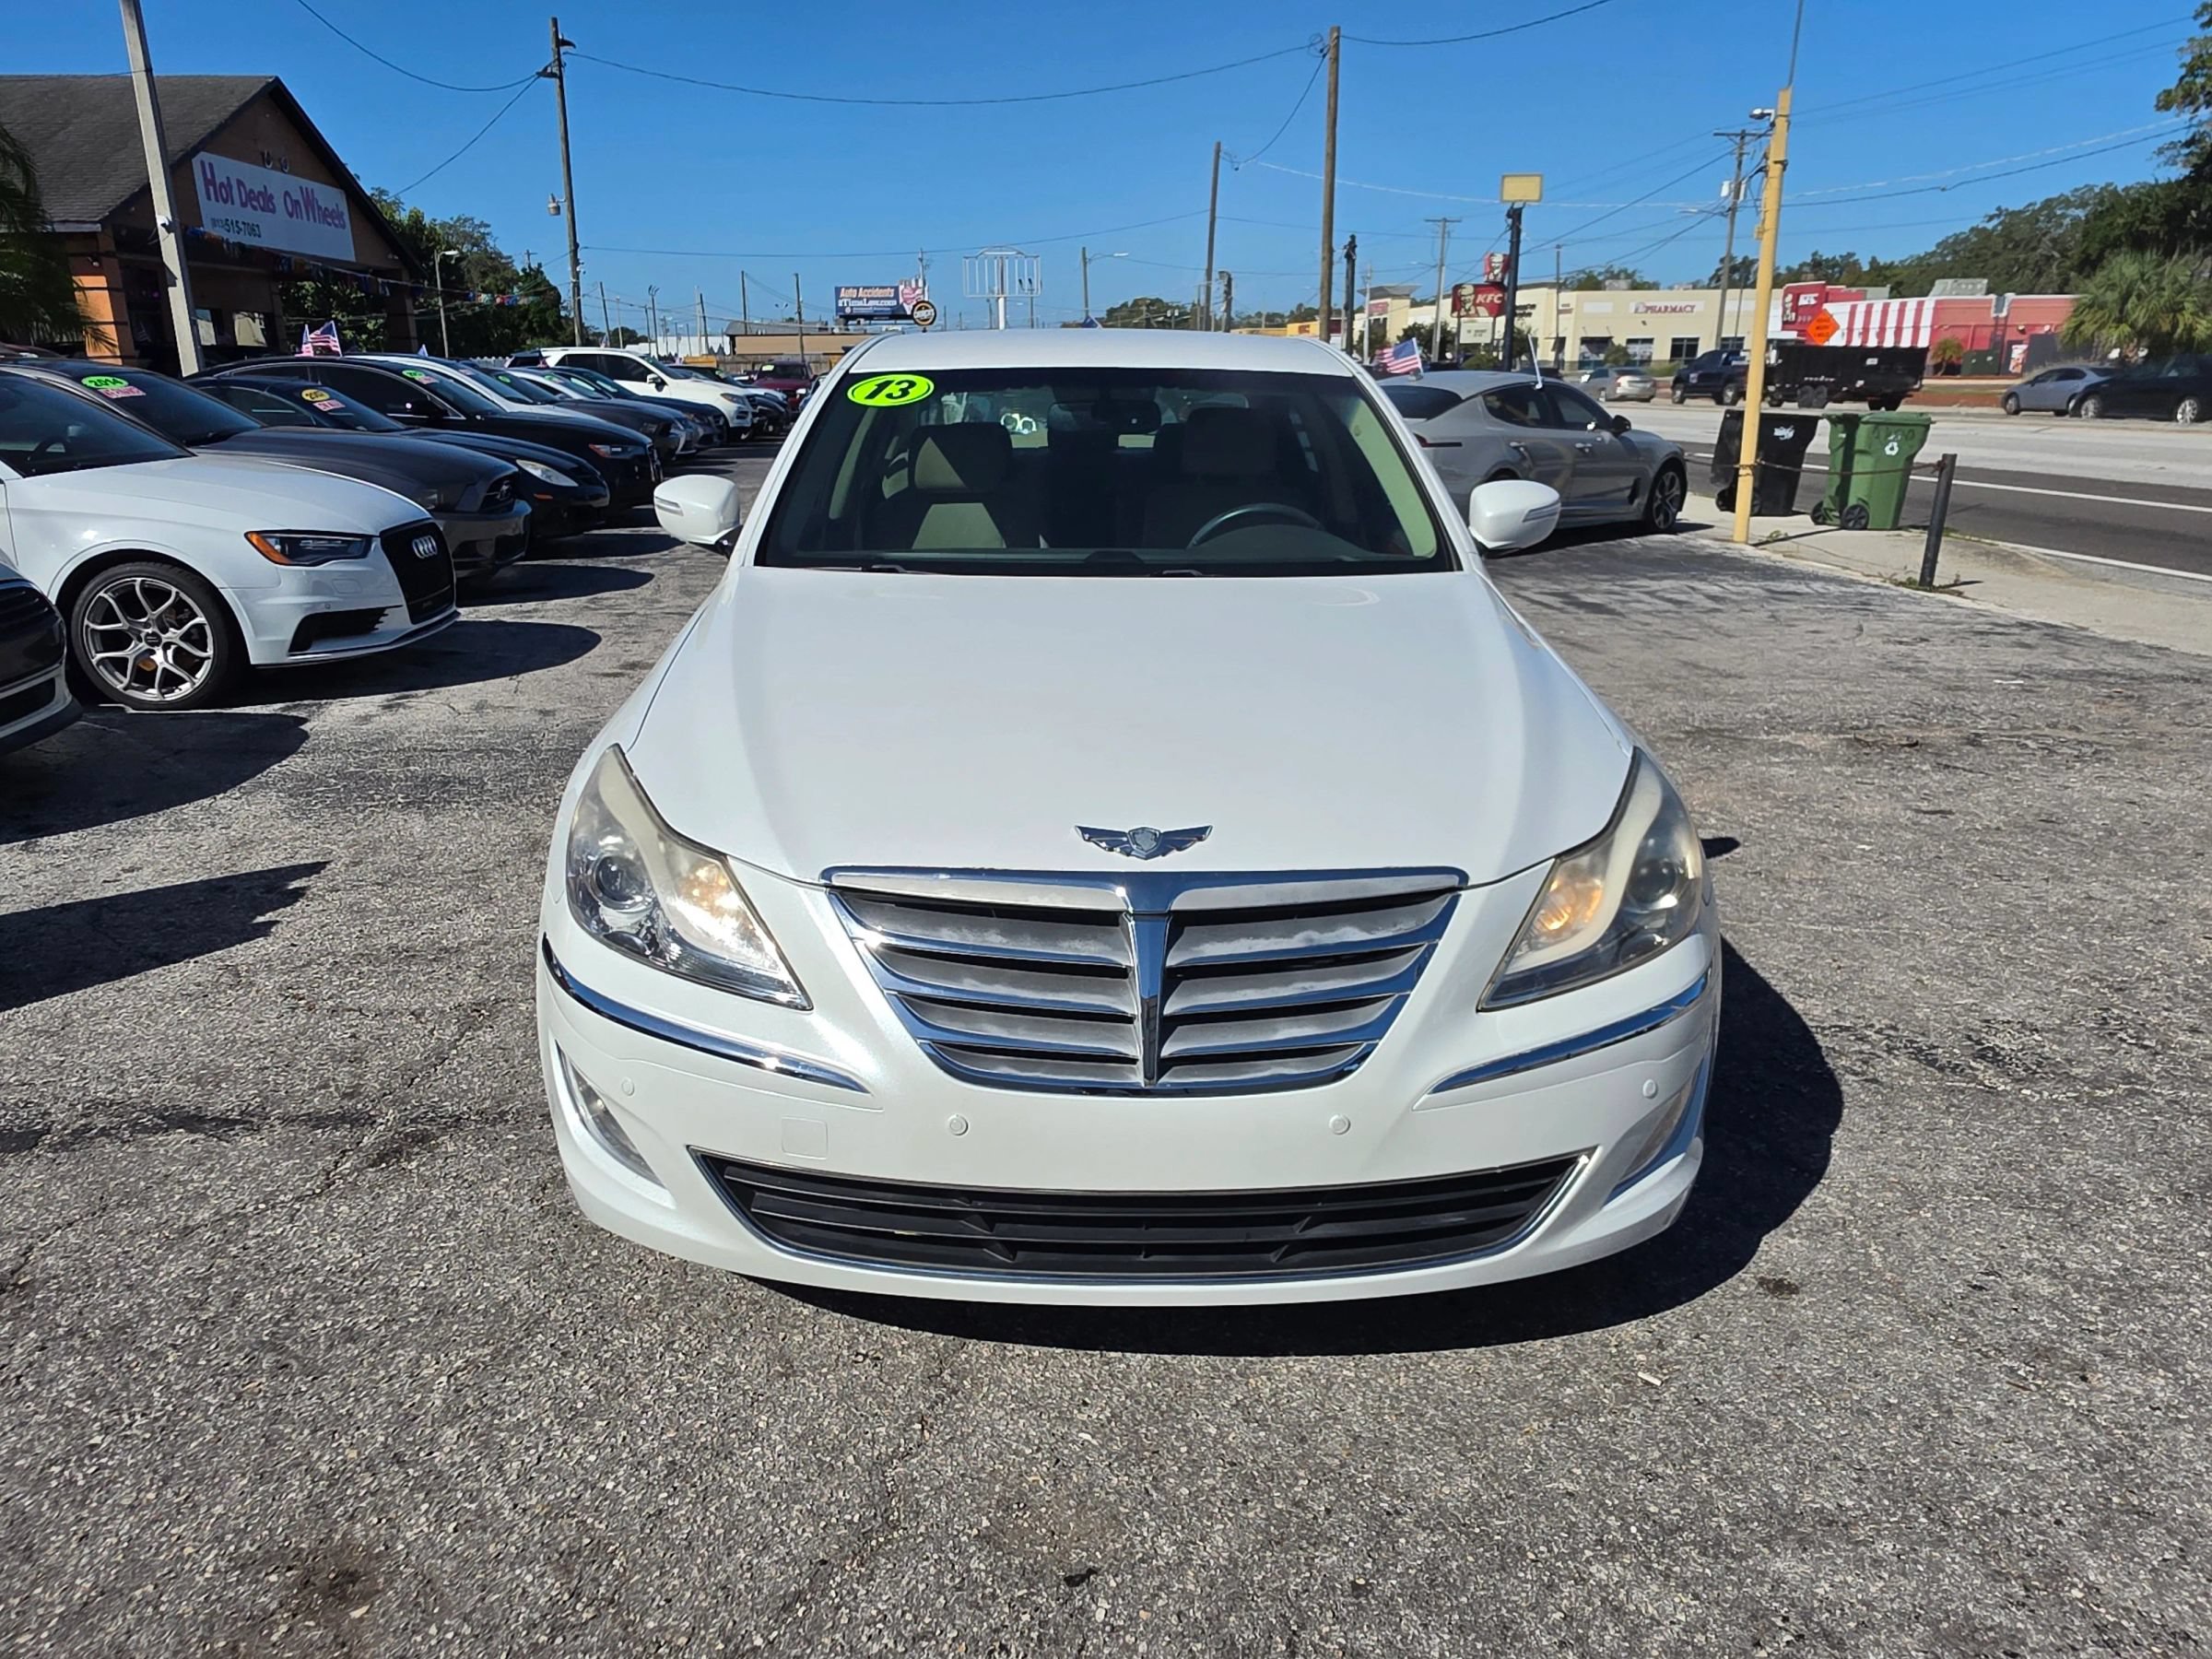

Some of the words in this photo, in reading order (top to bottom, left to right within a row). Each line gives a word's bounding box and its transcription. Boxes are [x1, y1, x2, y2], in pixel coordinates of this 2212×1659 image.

[200, 159, 235, 206] Hot
[236, 178, 276, 215] Deals
[283, 190, 304, 221] On
[300, 185, 347, 230] Wheels
[840, 288, 857, 298] Auto
[858, 288, 895, 298] Accidents
[1476, 293, 1503, 303] KFC
[1644, 304, 1696, 314] PHARMACY
[865, 379, 918, 400] 13
